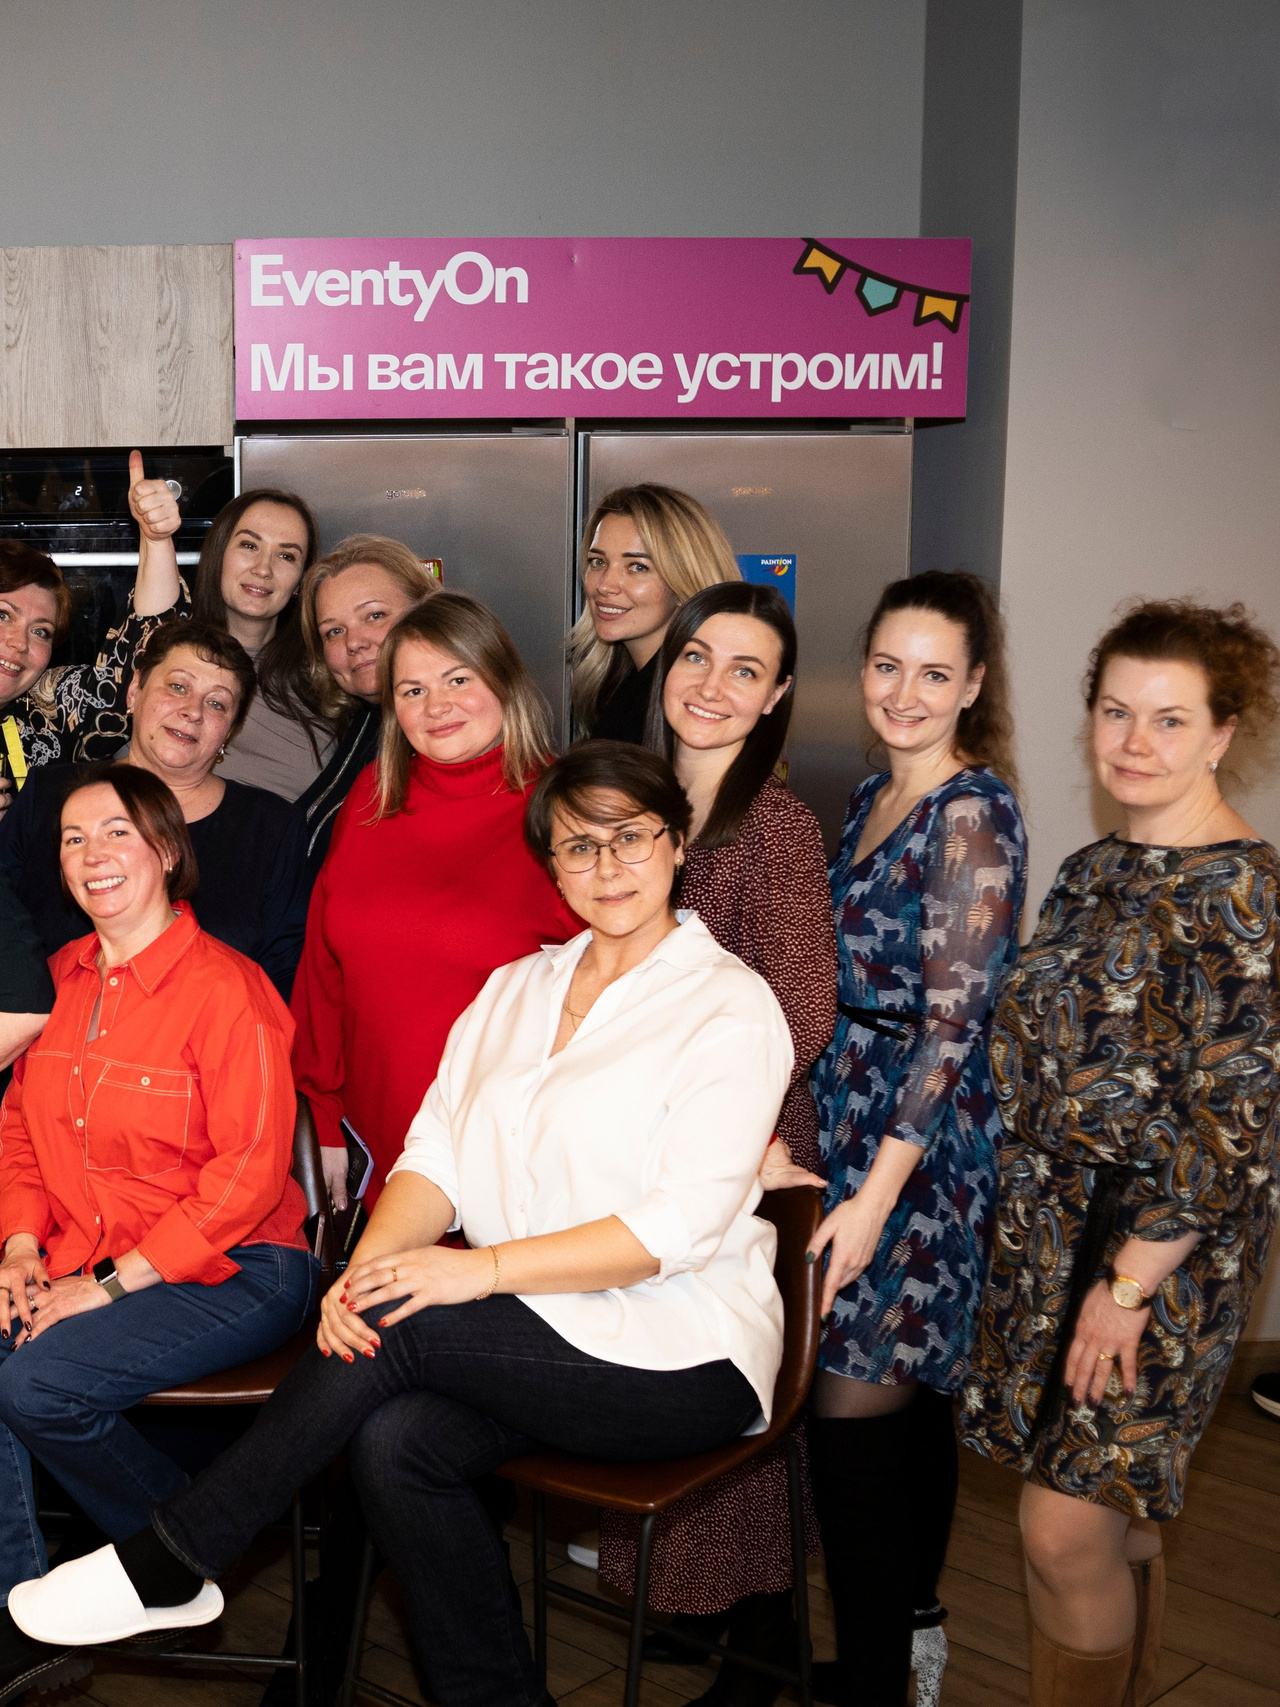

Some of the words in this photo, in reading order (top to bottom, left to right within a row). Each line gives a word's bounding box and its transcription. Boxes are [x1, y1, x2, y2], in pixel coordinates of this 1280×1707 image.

[250, 251, 529, 322] EventyOn
[250, 343, 354, 391] Мы
[368, 353, 483, 391] вам
[494, 352, 663, 391] такое
[673, 342, 944, 403] устроим!
